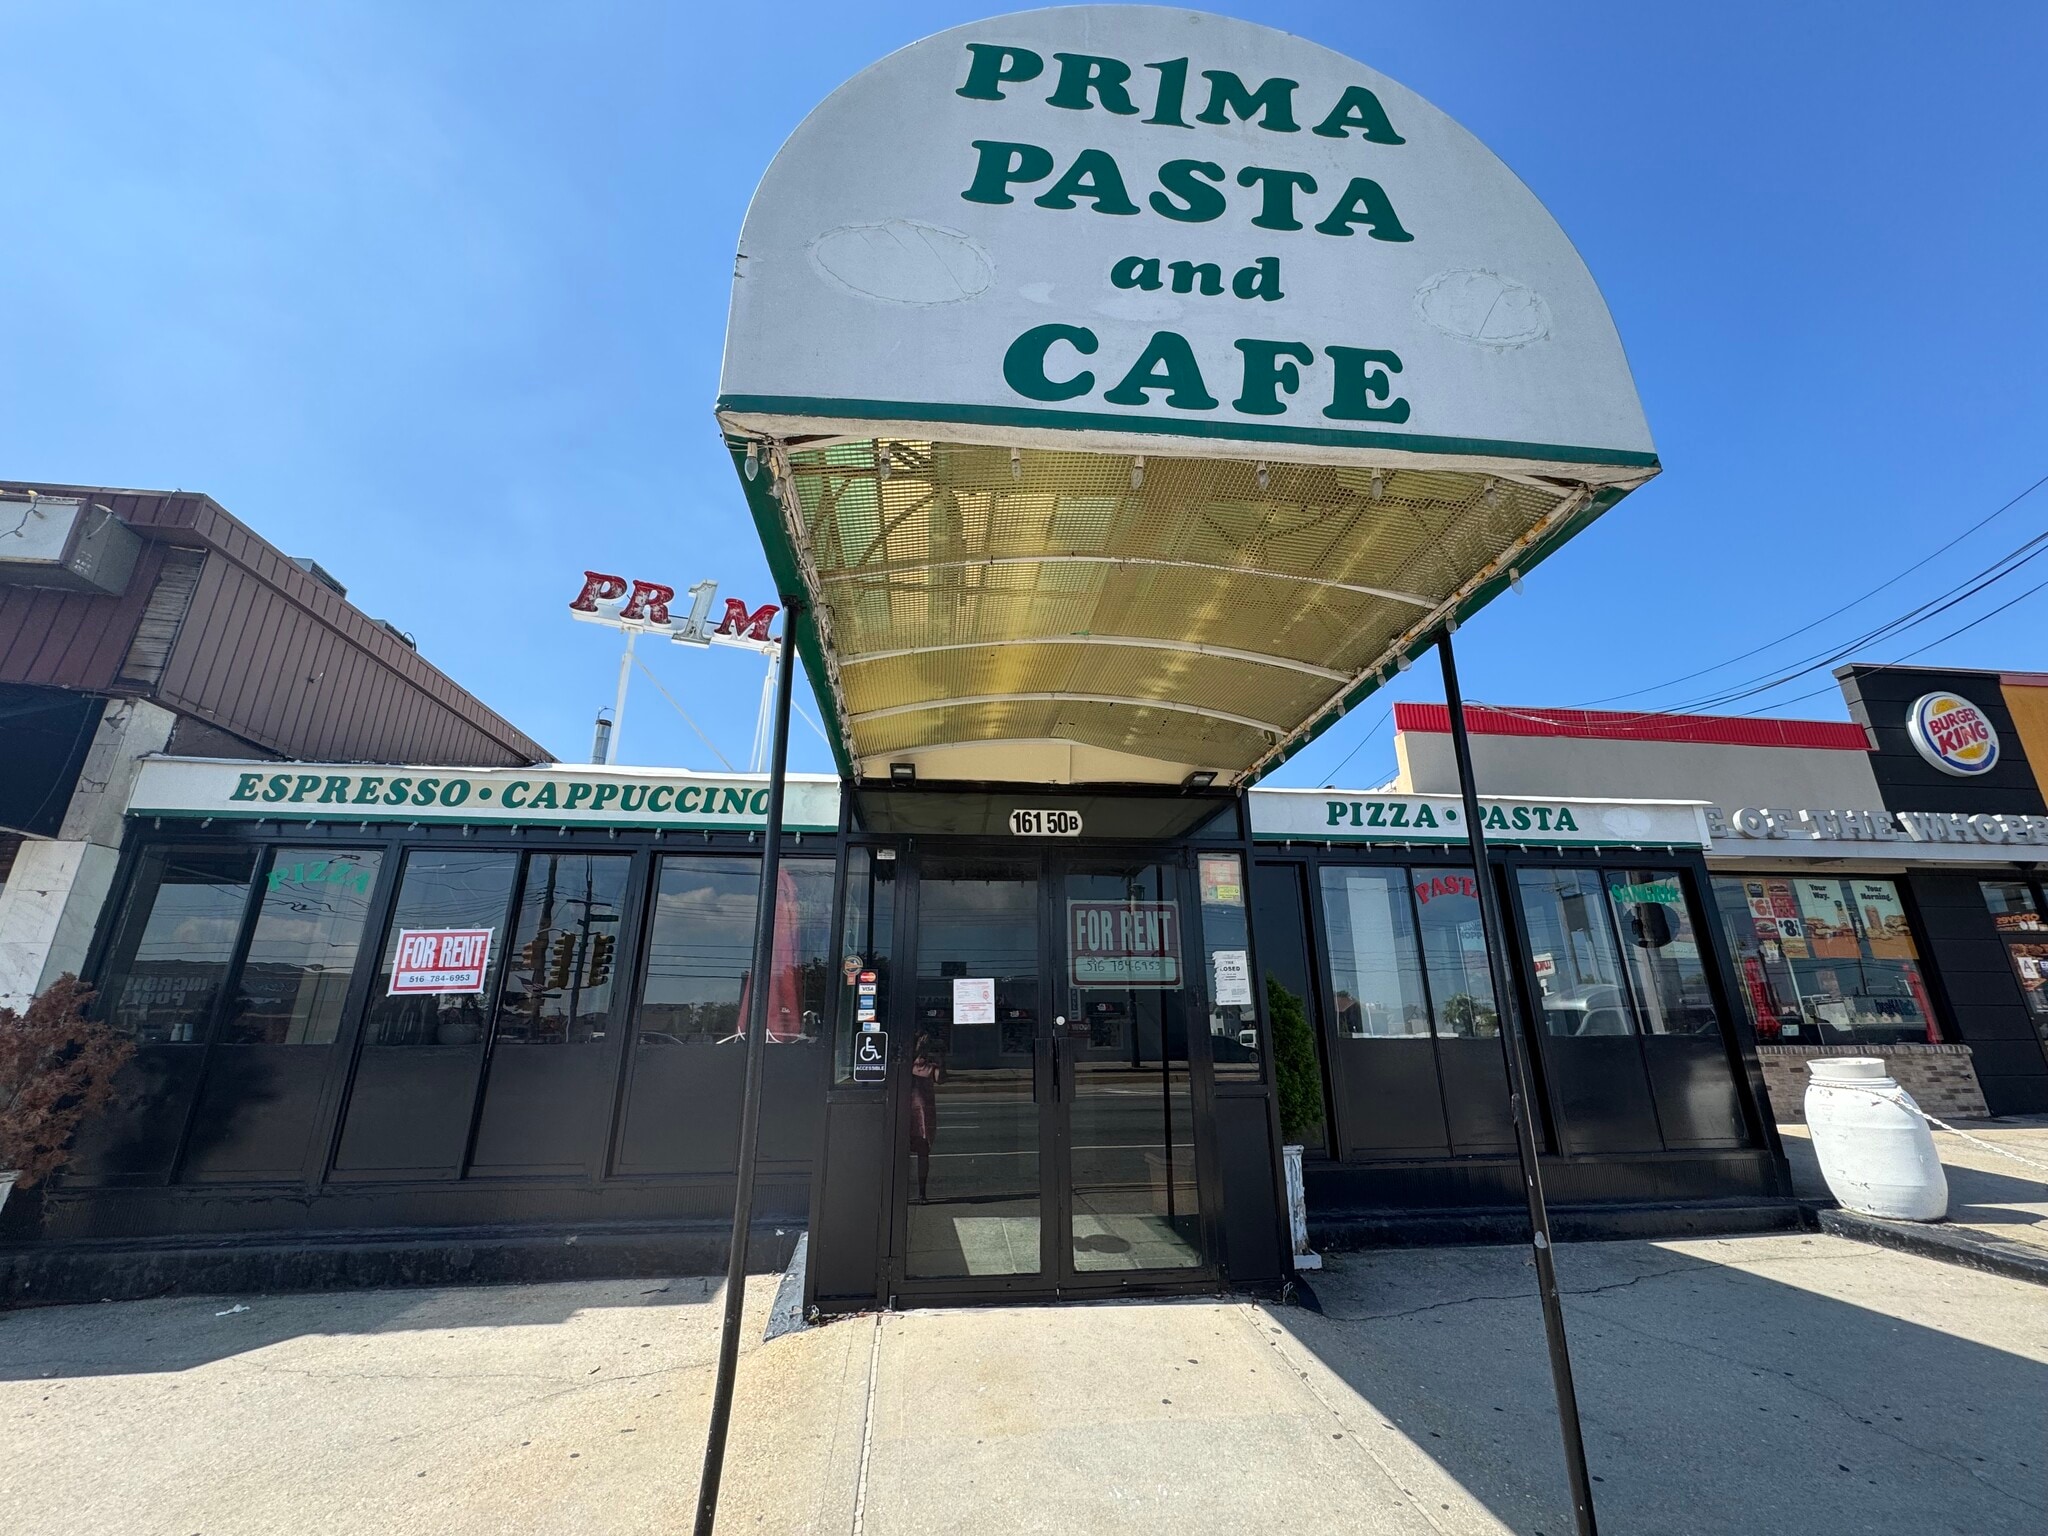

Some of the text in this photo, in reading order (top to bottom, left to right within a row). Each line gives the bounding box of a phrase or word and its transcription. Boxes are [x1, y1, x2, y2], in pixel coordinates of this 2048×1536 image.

[960, 139, 1414, 242] PASTA
[1110, 255, 1285, 301] and
[1003, 323, 1411, 424] CAFE
[569, 571, 781, 648] PR1M
[1929, 708, 1979, 735] BURGER
[1937, 721, 1989, 756] KING
[229, 773, 771, 815] ESPRESSO CAPPUCCINO
[1326, 801, 1439, 828] PIZZA
[1733, 807, 1794, 839] OF
[1799, 809, 1899, 840] THE
[266, 860, 371, 895] PIZZA
[1415, 873, 1477, 905] PAST
[1809, 884, 1827, 892] Your
[1860, 893, 1893, 901] Morning.
[1076, 910, 1171, 951] FOR RENT
[400, 935, 486, 968] FOR RENT
[1084, 959, 1105, 971] 516
[2023, 960, 2034, 972] A
[409, 974, 470, 983] 516 784-6953
